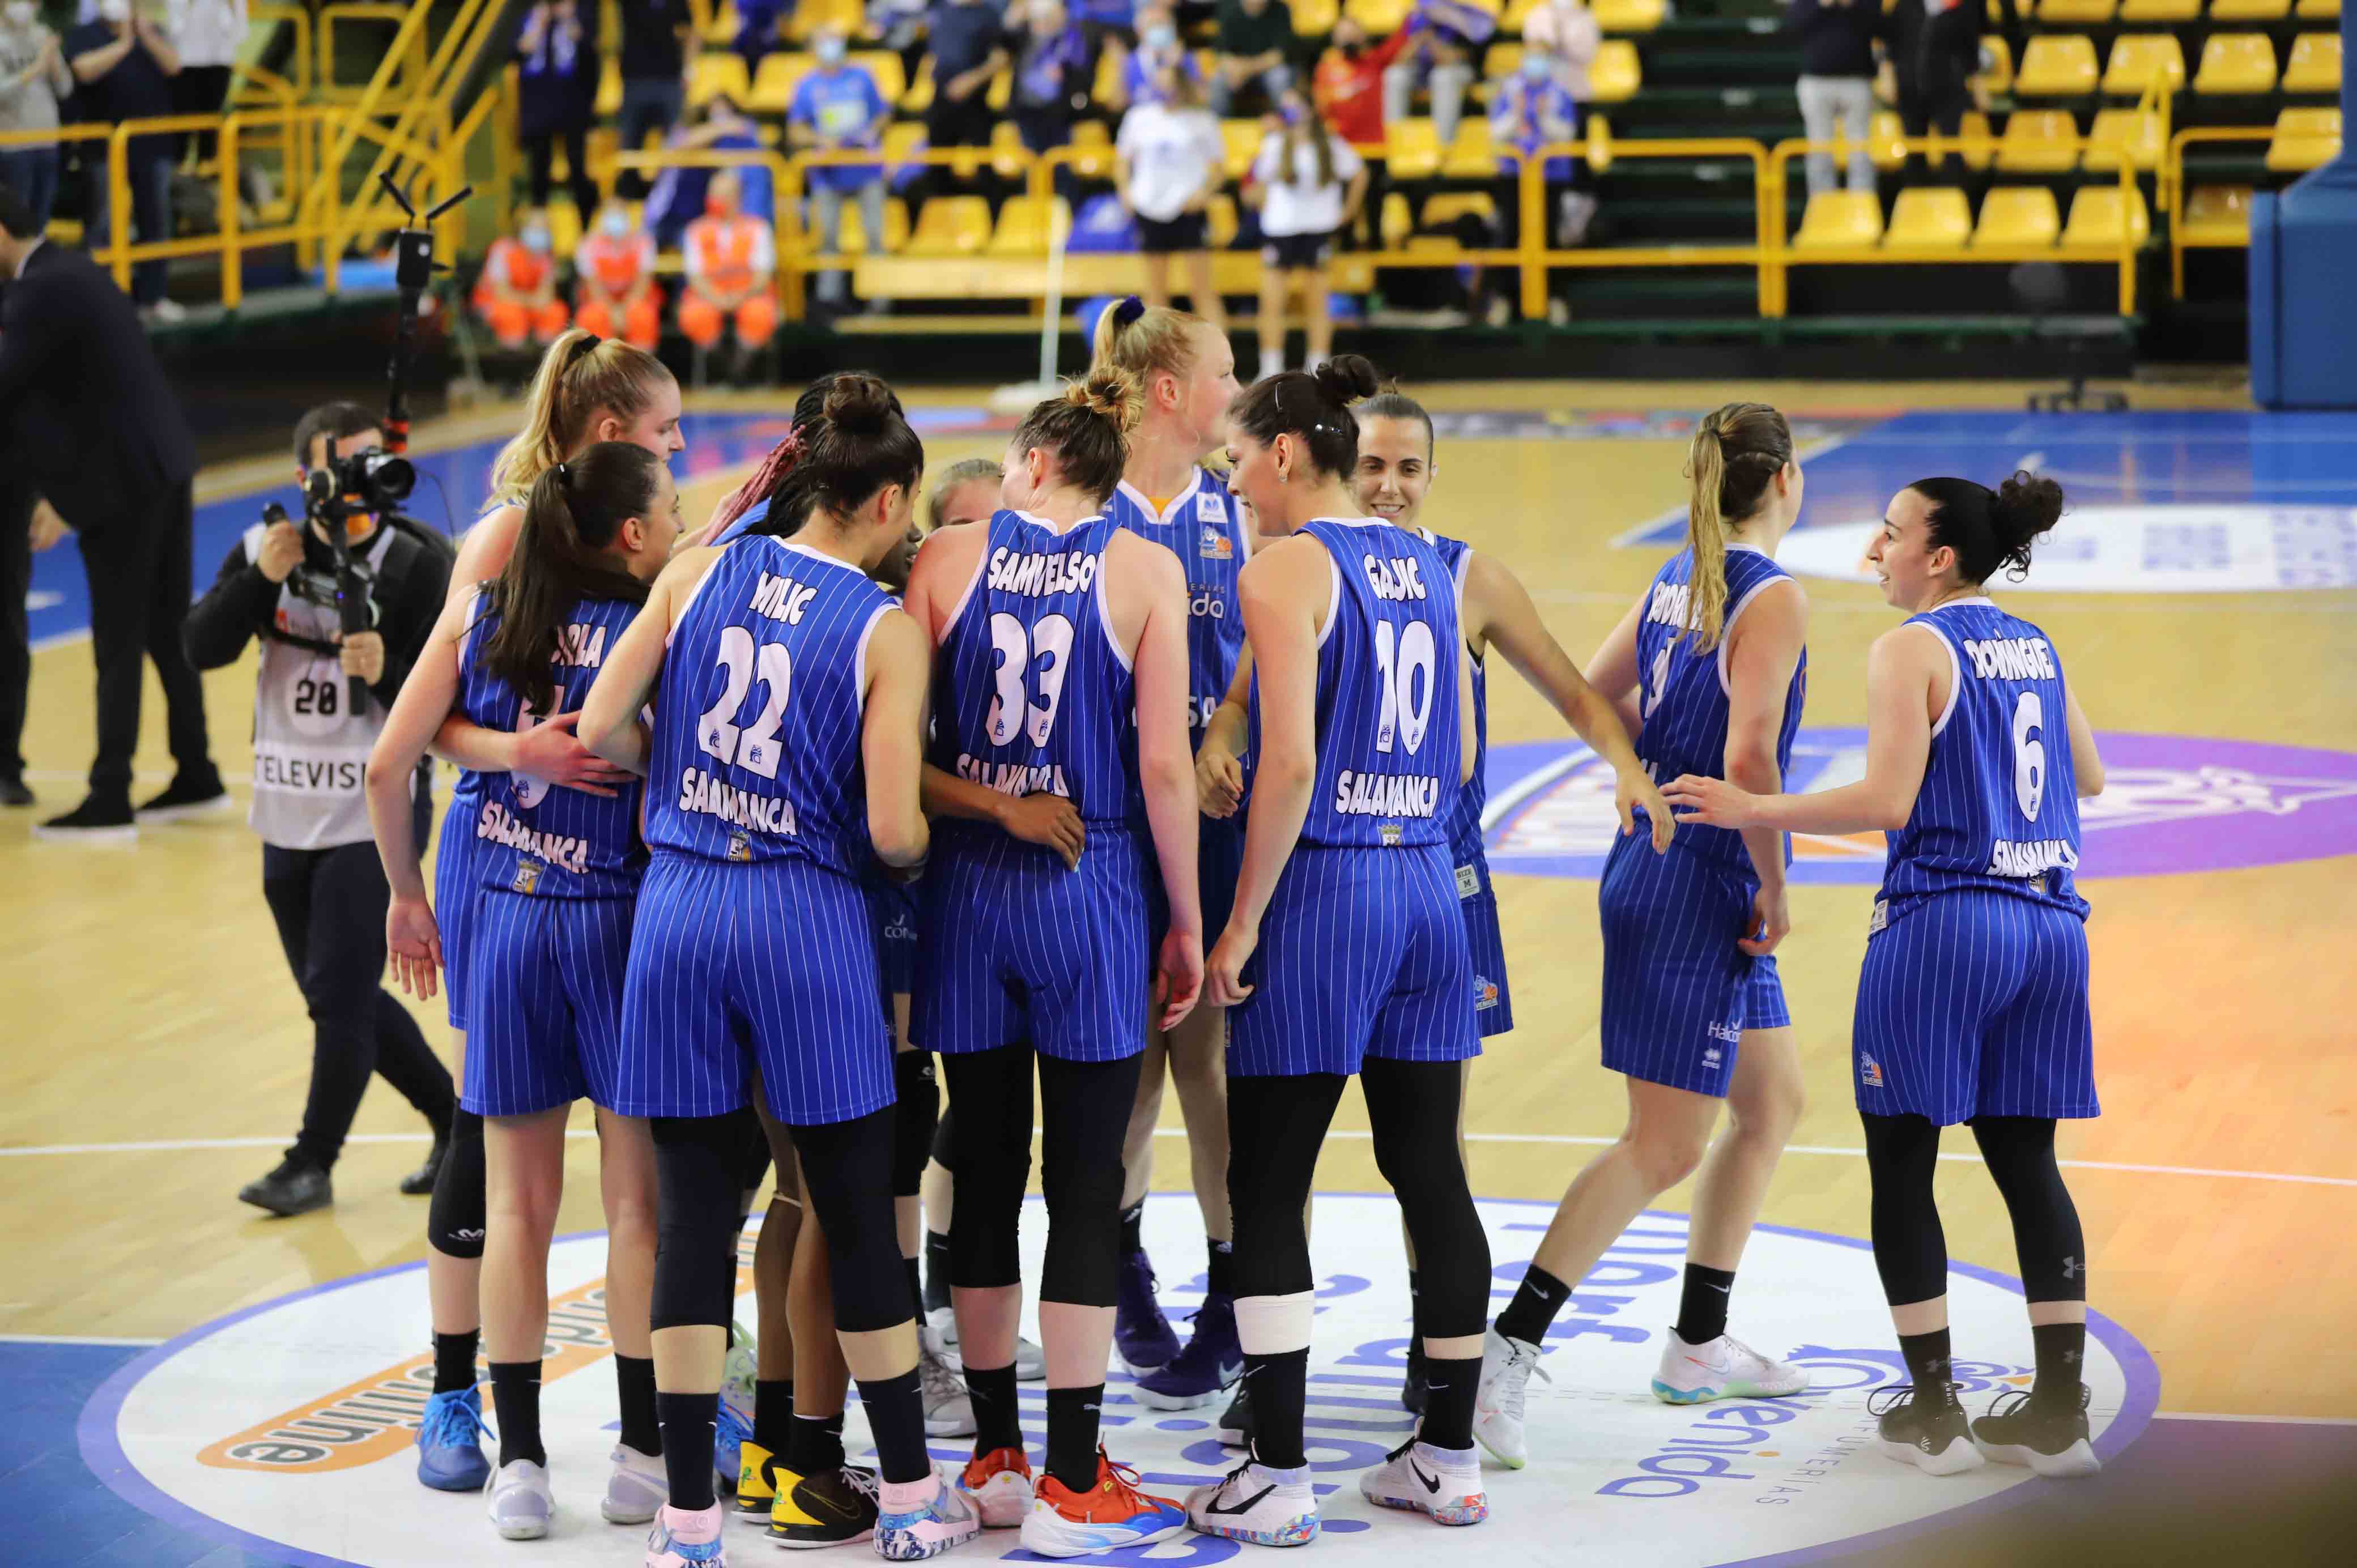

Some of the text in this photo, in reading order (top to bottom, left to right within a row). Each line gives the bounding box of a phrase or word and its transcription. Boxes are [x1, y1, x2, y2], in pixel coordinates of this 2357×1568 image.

[697, 625, 792, 780] 22
[986, 612, 1074, 748] 33
[1375, 619, 1436, 756] 10
[2012, 690, 2046, 824] 6
